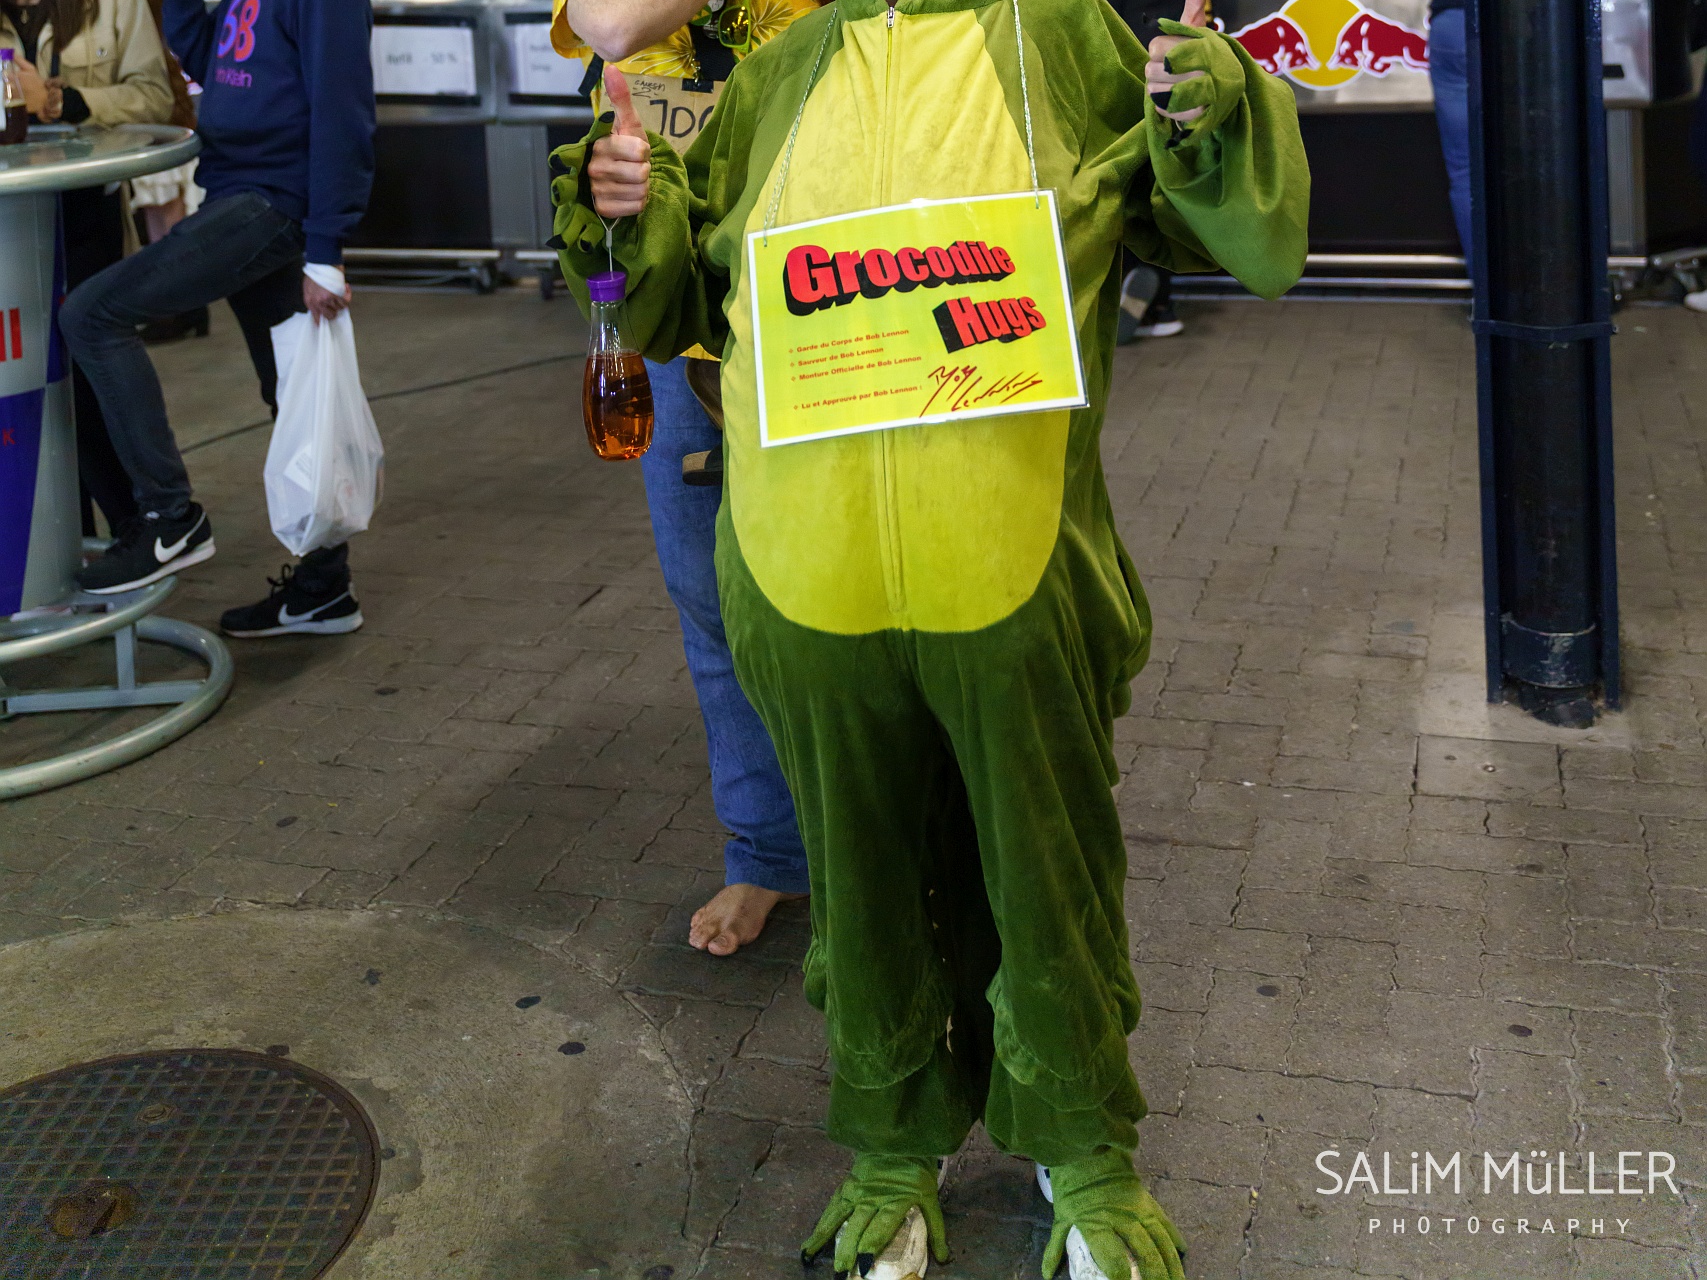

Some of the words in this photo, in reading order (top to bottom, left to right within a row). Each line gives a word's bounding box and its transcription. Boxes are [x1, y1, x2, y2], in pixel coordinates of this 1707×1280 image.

[783, 240, 1016, 316] Grocodile
[933, 296, 1047, 354] Hugs
[797, 344, 818, 353] Garde
[831, 338, 853, 347] Corps
[882, 329, 909, 338] Lennon
[798, 357, 827, 366] Sauveur
[840, 351, 855, 359] Bob
[856, 347, 884, 356] Lennon
[799, 370, 829, 380] Monture
[831, 365, 864, 375] Officielle
[878, 359, 892, 367] Bob
[894, 356, 922, 365] Lennon
[822, 395, 857, 406] Approuvé
[859, 392, 871, 400] par
[873, 389, 888, 397] Bob
[890, 385, 918, 394] Lennon
